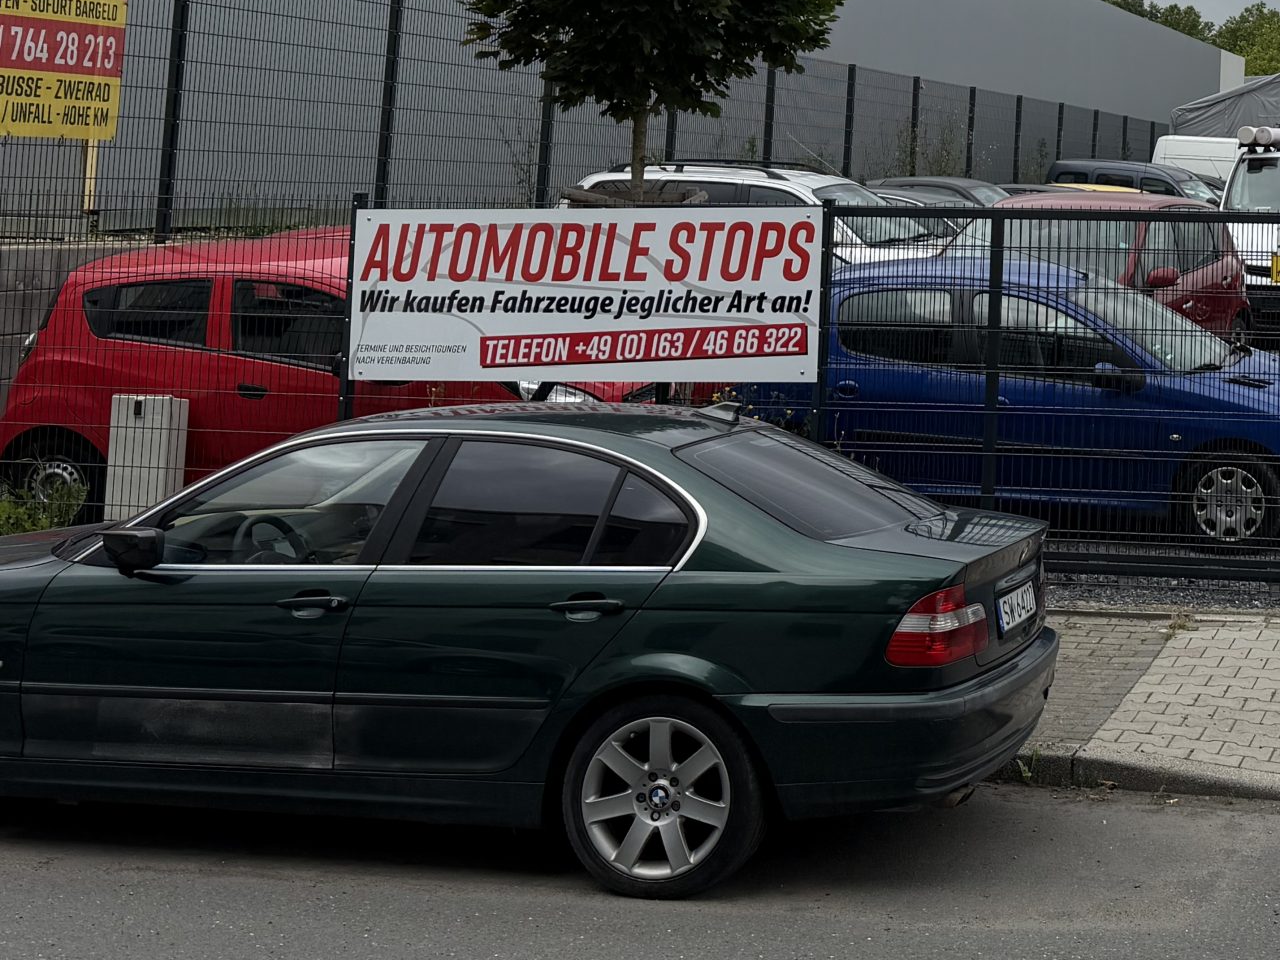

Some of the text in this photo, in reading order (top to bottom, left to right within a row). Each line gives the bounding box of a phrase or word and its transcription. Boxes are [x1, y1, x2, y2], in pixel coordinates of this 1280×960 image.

[10, 25, 49, 63] 764
[54, 31, 79, 66] 28
[83, 34, 116, 70] 213
[54, 79, 111, 103] ZWEIRAD
[11, 102, 53, 124] UNFALL
[62, 104, 92, 127] HOHE
[93, 107, 109, 127] KM
[360, 221, 816, 283] AUTOMOBILE STOPS
[359, 289, 813, 319] Wir kaufen Fahrzeuge jeglicher Art an!
[356, 343, 467, 354] TERMINE UND BESICHTIGUNGEN
[485, 327, 801, 365] TELEFON +49 (0) 163 / 46 66 322
[355, 356, 432, 365] NACH VEREINBARUNG
